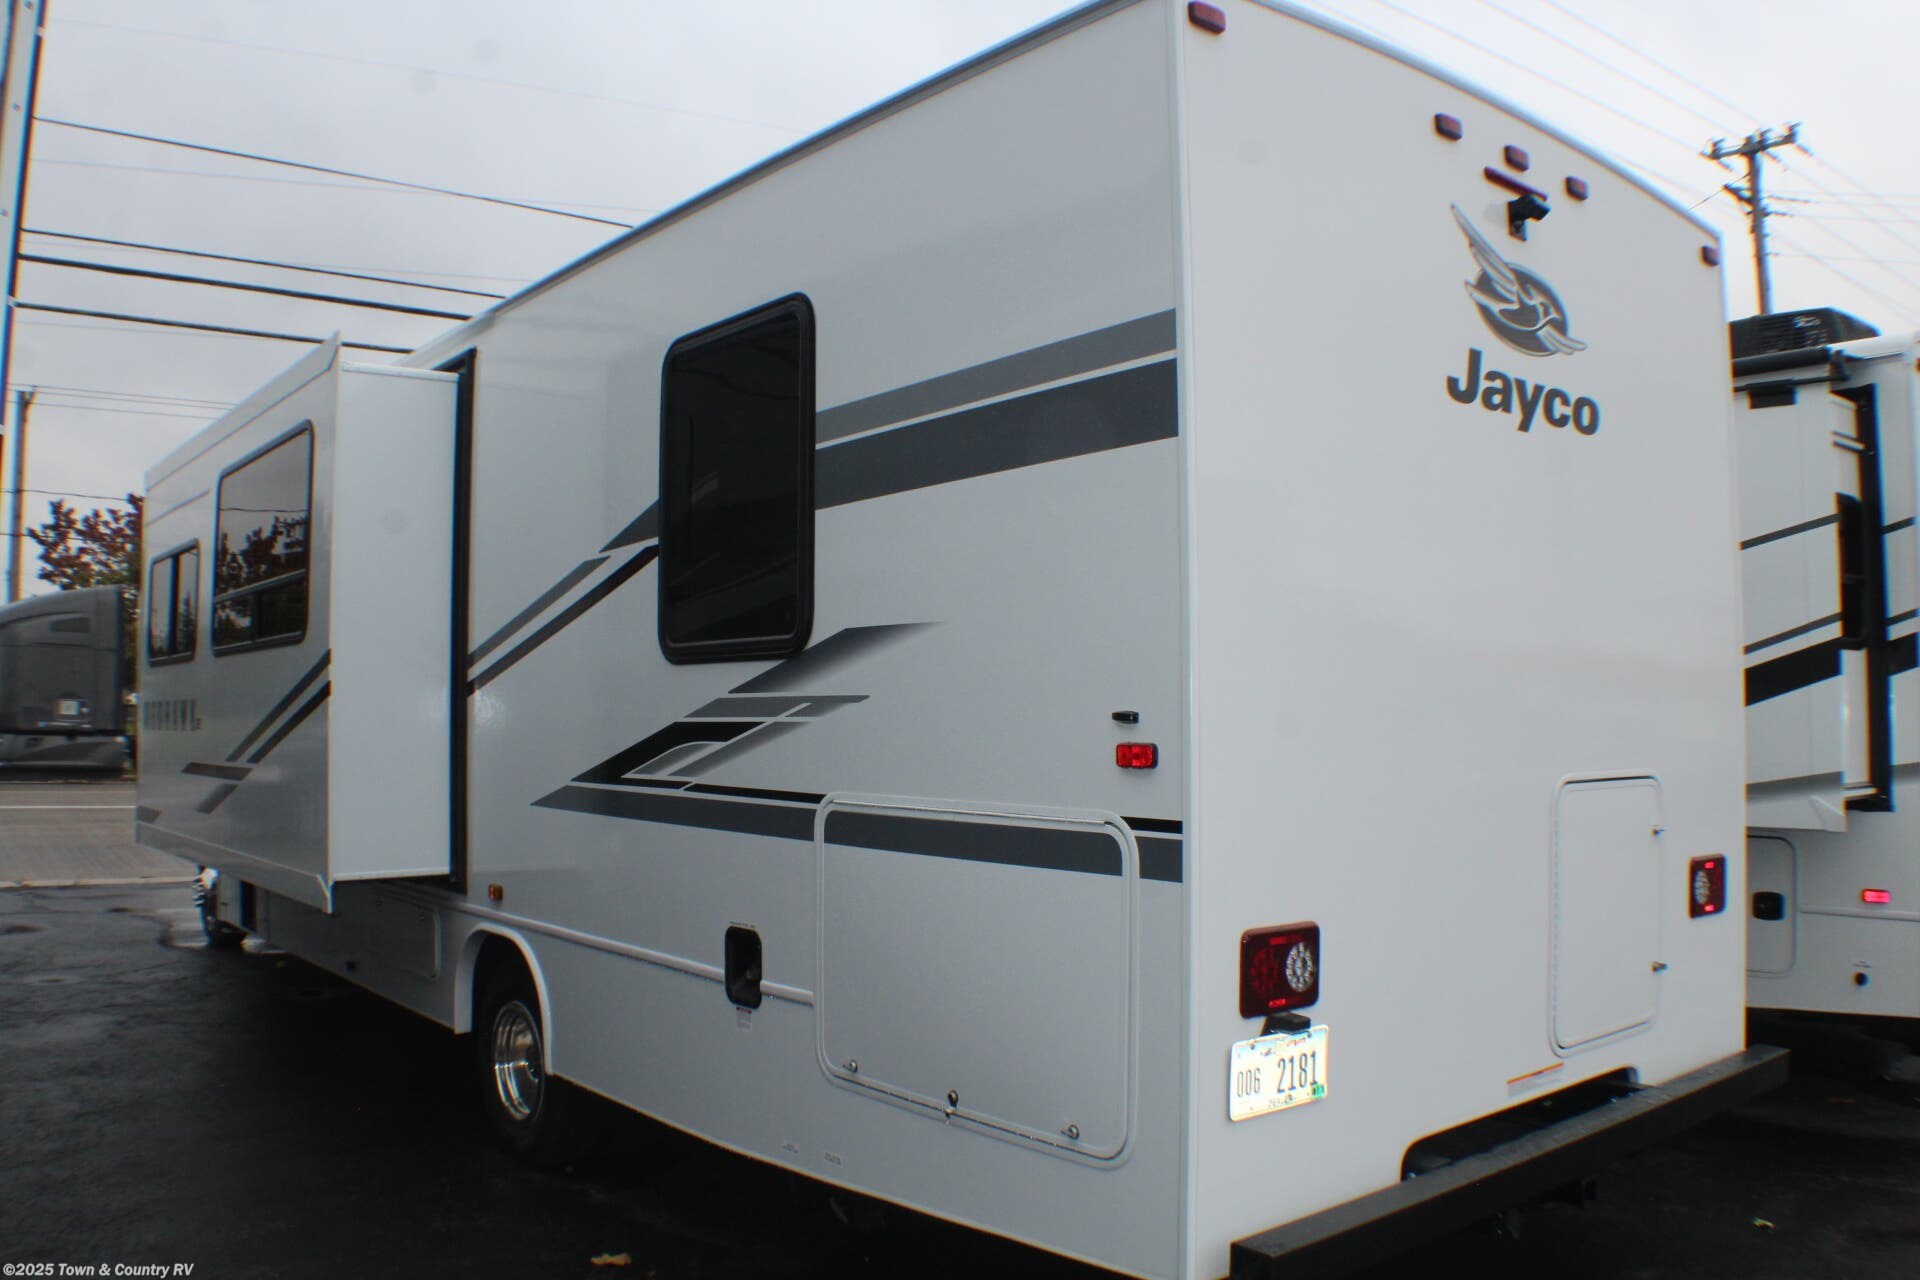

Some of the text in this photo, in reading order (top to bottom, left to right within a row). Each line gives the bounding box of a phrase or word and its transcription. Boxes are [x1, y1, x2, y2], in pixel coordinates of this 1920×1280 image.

[1446, 347, 1600, 436] Jayco
[1237, 1050, 1318, 1098] 006 2181
